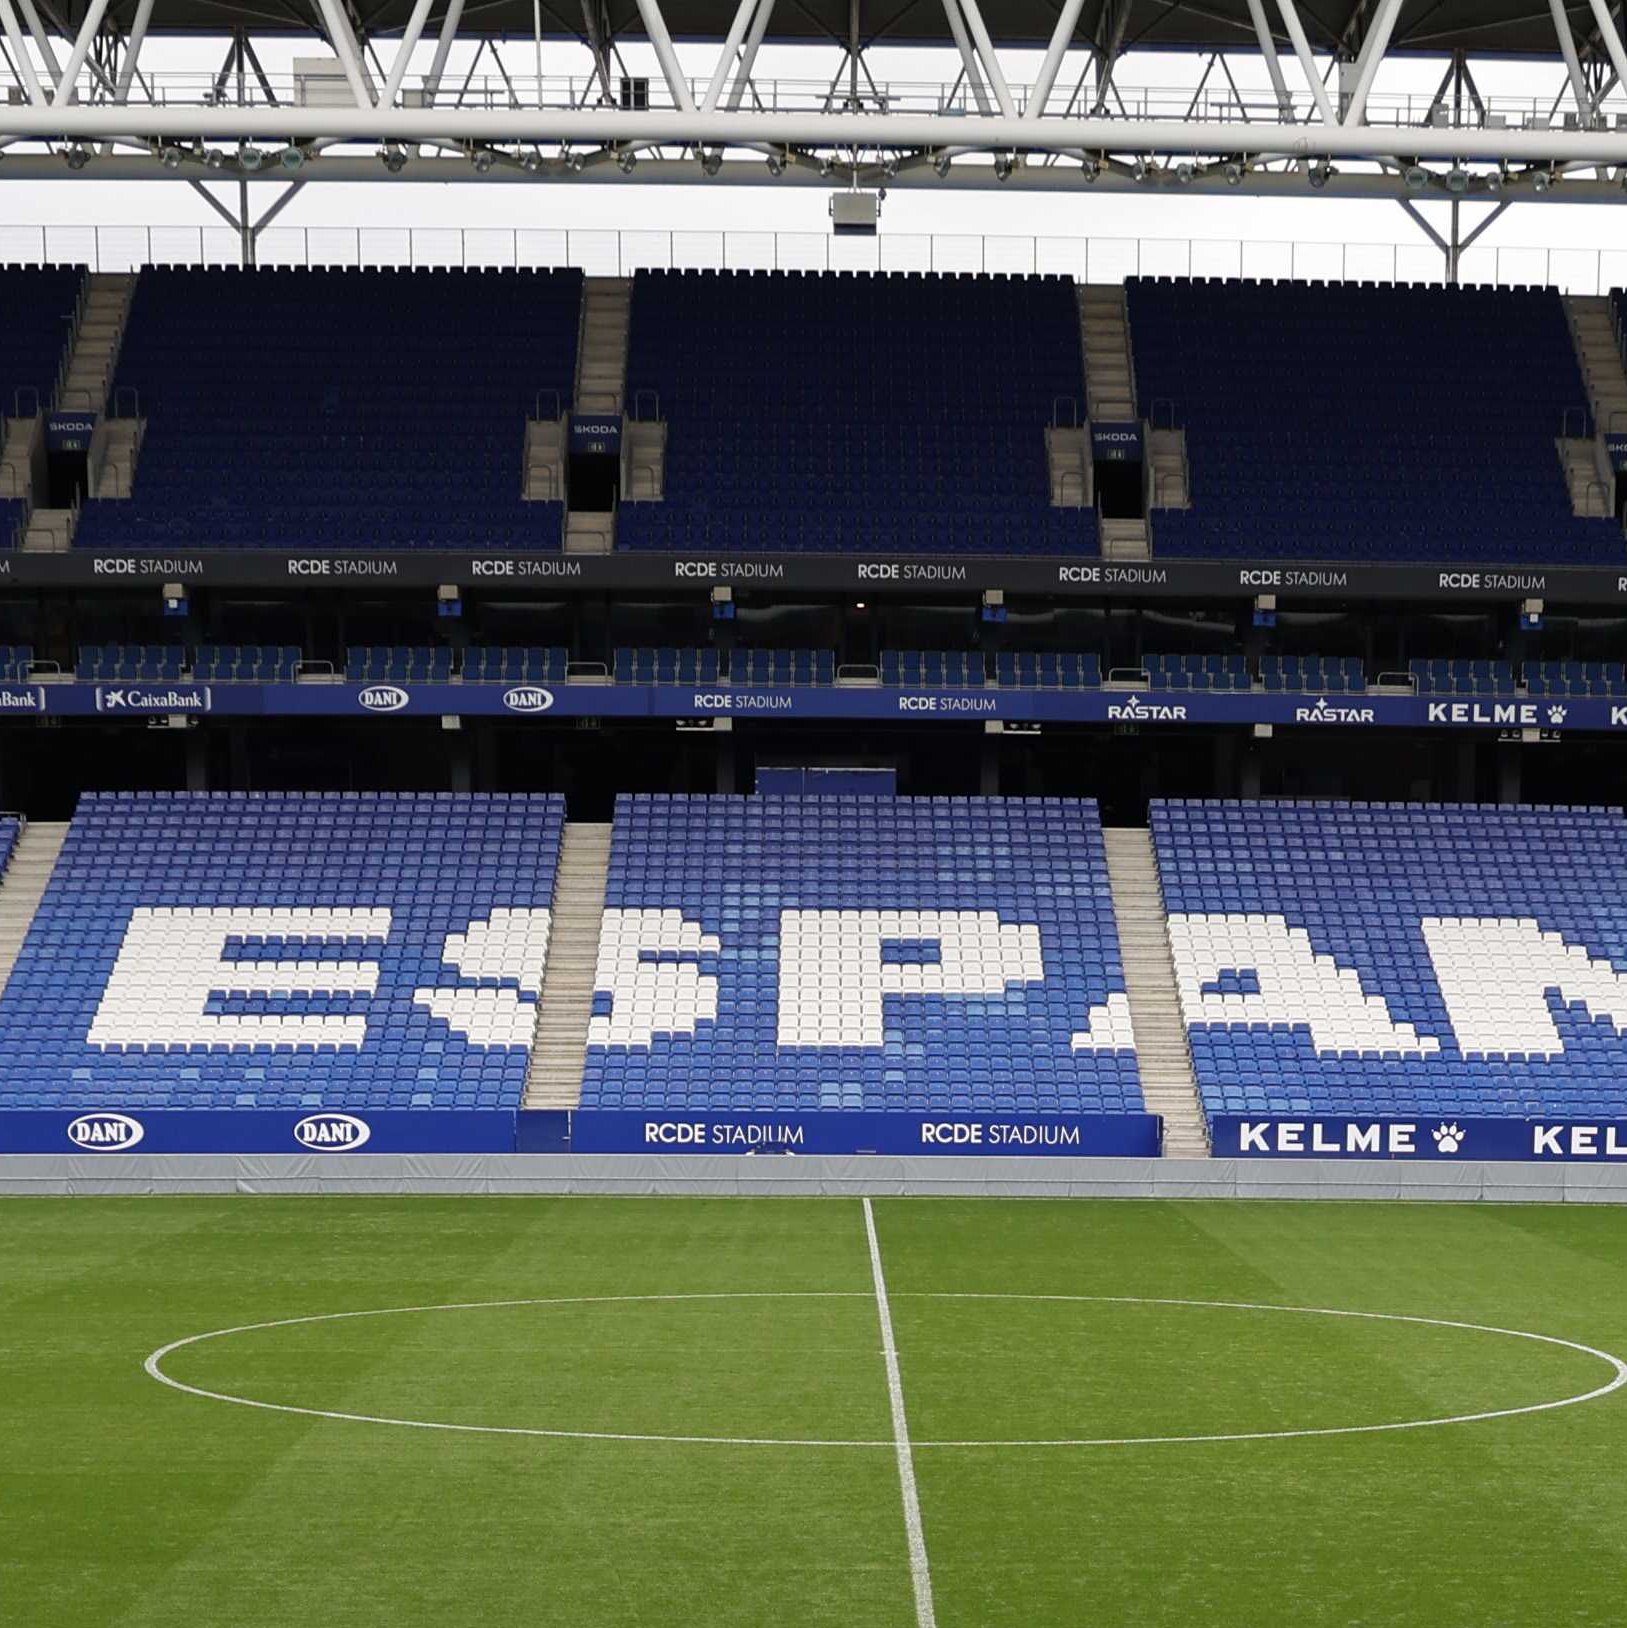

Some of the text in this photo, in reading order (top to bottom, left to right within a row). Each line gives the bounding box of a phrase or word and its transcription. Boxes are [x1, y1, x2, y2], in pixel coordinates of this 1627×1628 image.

[574, 425, 619, 435] SKODA
[1095, 432, 1139, 442] SKODA
[93, 558, 203, 574] RCDE STADIUM
[288, 559, 397, 575] RCDE STADIUM
[472, 560, 581, 576] RCDE STADIUM
[675, 561, 784, 577] RCDE STADIUM
[857, 563, 966, 580] RCDE STADIUM
[1059, 566, 1167, 583] RCDE STADIUM
[1240, 570, 1347, 586] RCDE STADIUM
[1439, 573, 1545, 589] RCDE STADIUM
[126, 690, 202, 706] CaixaBank
[365, 691, 397, 706] DANI
[509, 691, 541, 706] DANI
[694, 694, 792, 709] RCDE STADIUM
[899, 696, 996, 711] RCDE STADIUM
[1108, 705, 1186, 720] RASTAR
[1296, 707, 1374, 722] RASTAR
[1428, 703, 1538, 724] KELME
[75, 1120, 127, 1143] DANI
[302, 1120, 353, 1144] DANI
[645, 1122, 804, 1144] RCDE STADIUM
[922, 1123, 1080, 1145] RCDE STADIUM
[1240, 1122, 1416, 1153] KELME
